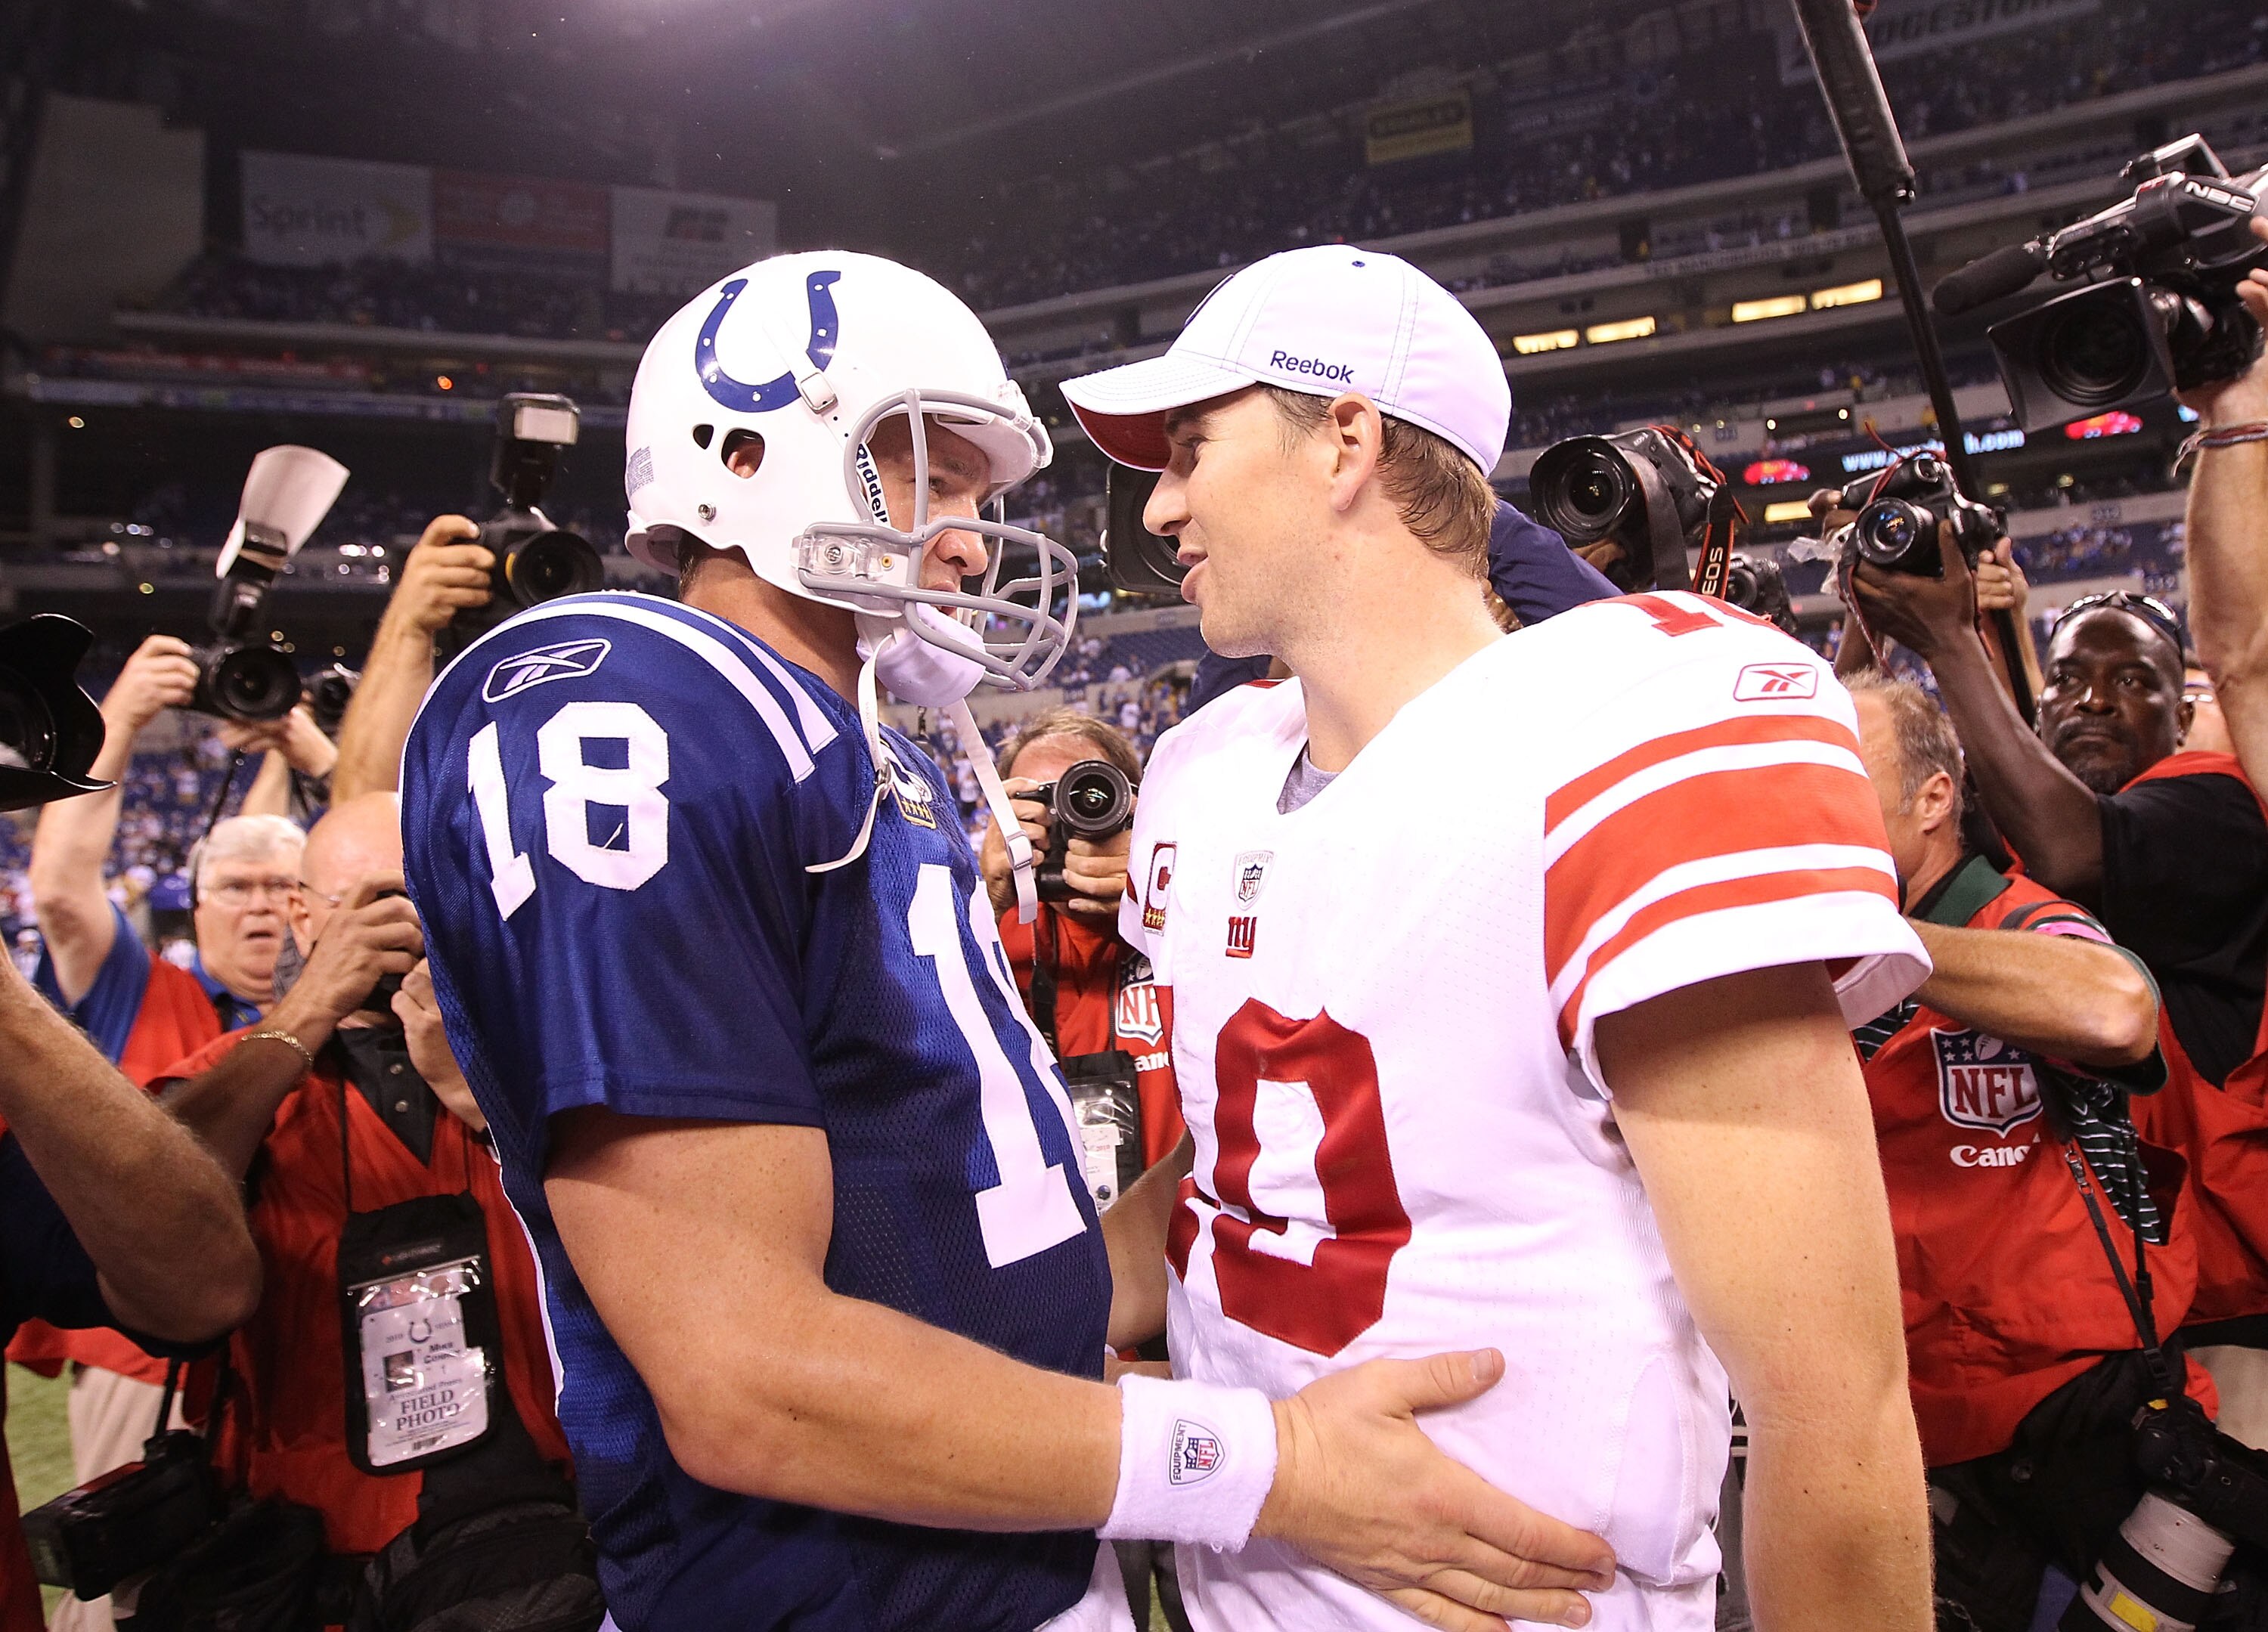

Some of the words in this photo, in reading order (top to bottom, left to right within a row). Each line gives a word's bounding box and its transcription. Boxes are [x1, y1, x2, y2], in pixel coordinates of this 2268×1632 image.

[2185, 181, 2255, 212] NBC
[250, 194, 366, 239] Sprint
[1270, 350, 1355, 384] Reebok
[1702, 547, 1724, 596] EOS
[467, 701, 670, 921] 18
[1240, 879, 1256, 898] NFL
[1952, 1067, 2037, 1119] NFL
[396, 1403, 460, 1431] PHOTO
[401, 1389, 454, 1414] FIELD
[1173, 1423, 1187, 1481] EQUIPMENT
[1197, 1442, 1216, 1469] NFL
